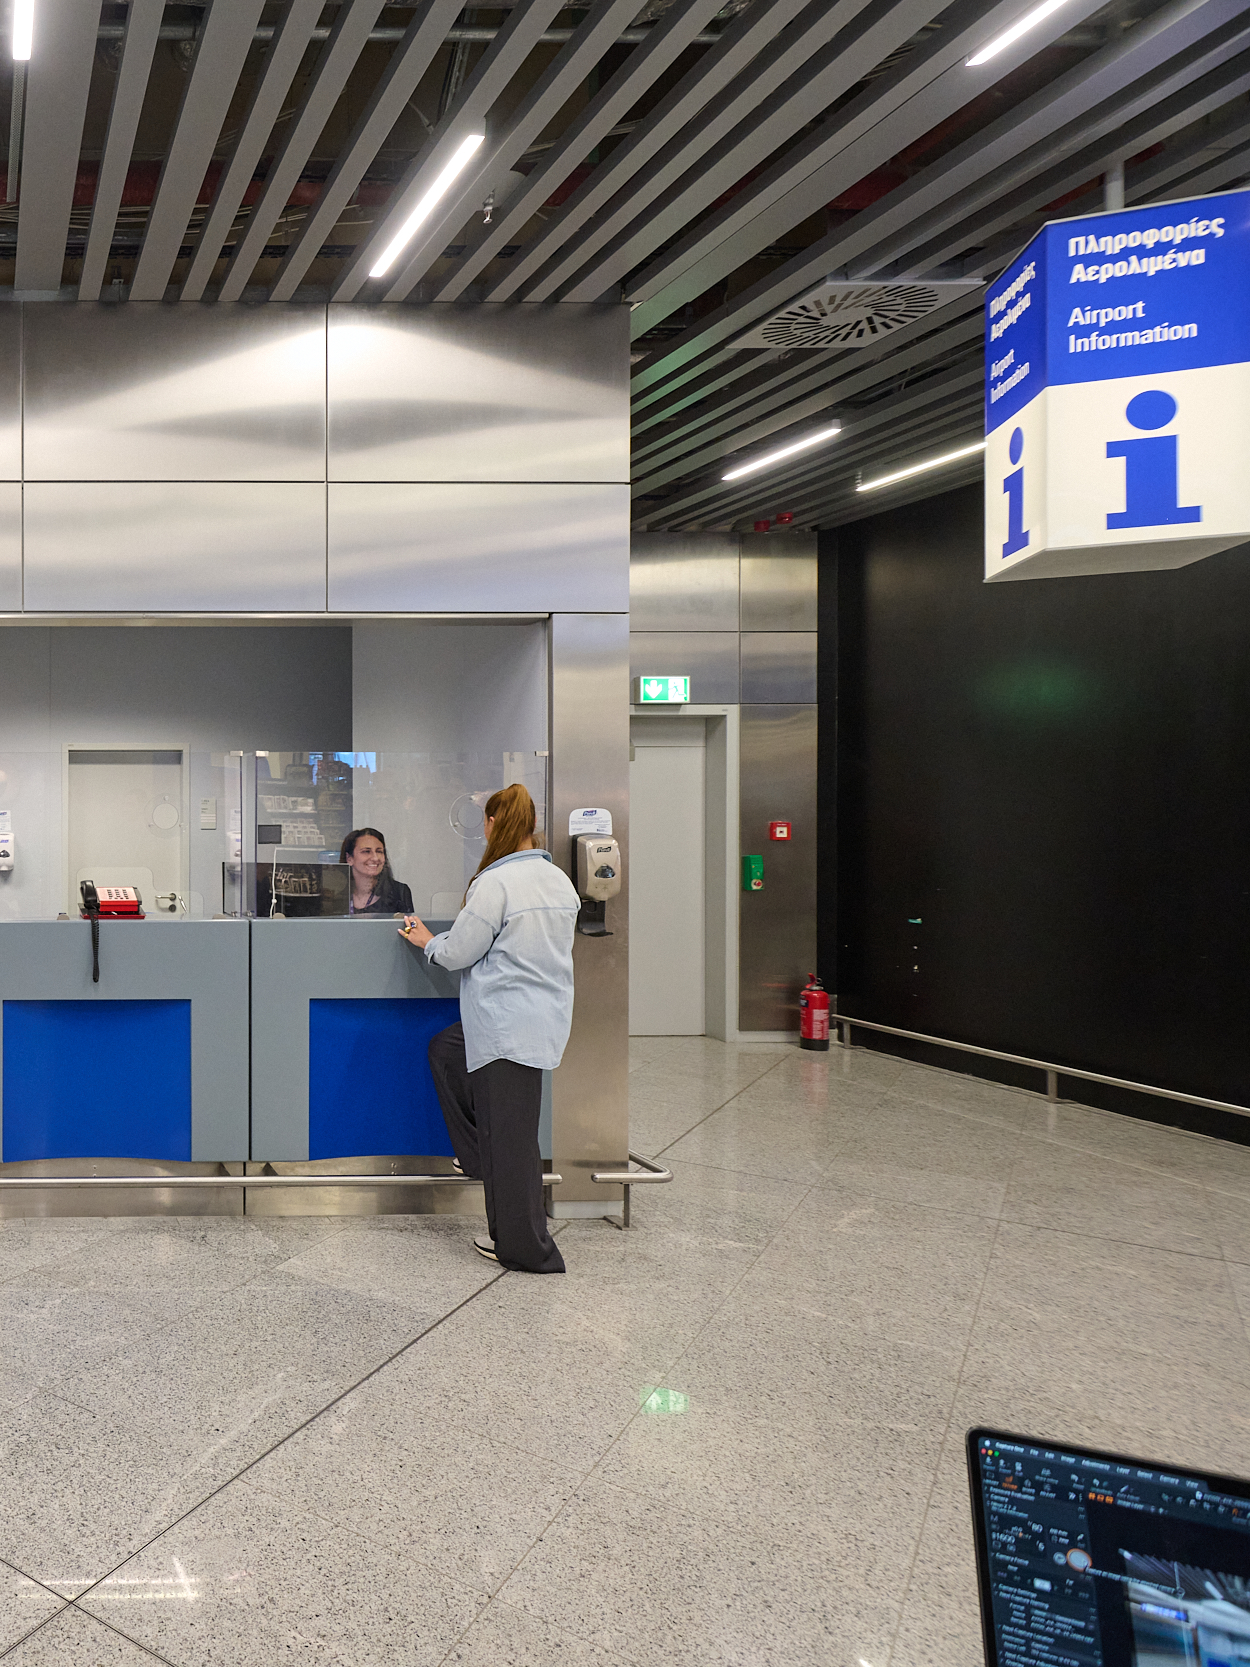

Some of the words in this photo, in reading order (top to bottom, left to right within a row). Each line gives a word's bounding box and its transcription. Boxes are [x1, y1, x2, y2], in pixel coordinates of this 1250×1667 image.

[1068, 216, 1225, 257] Πληροφορίες
[1069, 246, 1206, 284] Αερολιμένα
[1067, 300, 1146, 328] Airport
[1068, 321, 1198, 353] Information
[990, 348, 1015, 381] Airport
[990, 362, 1030, 404] Information
